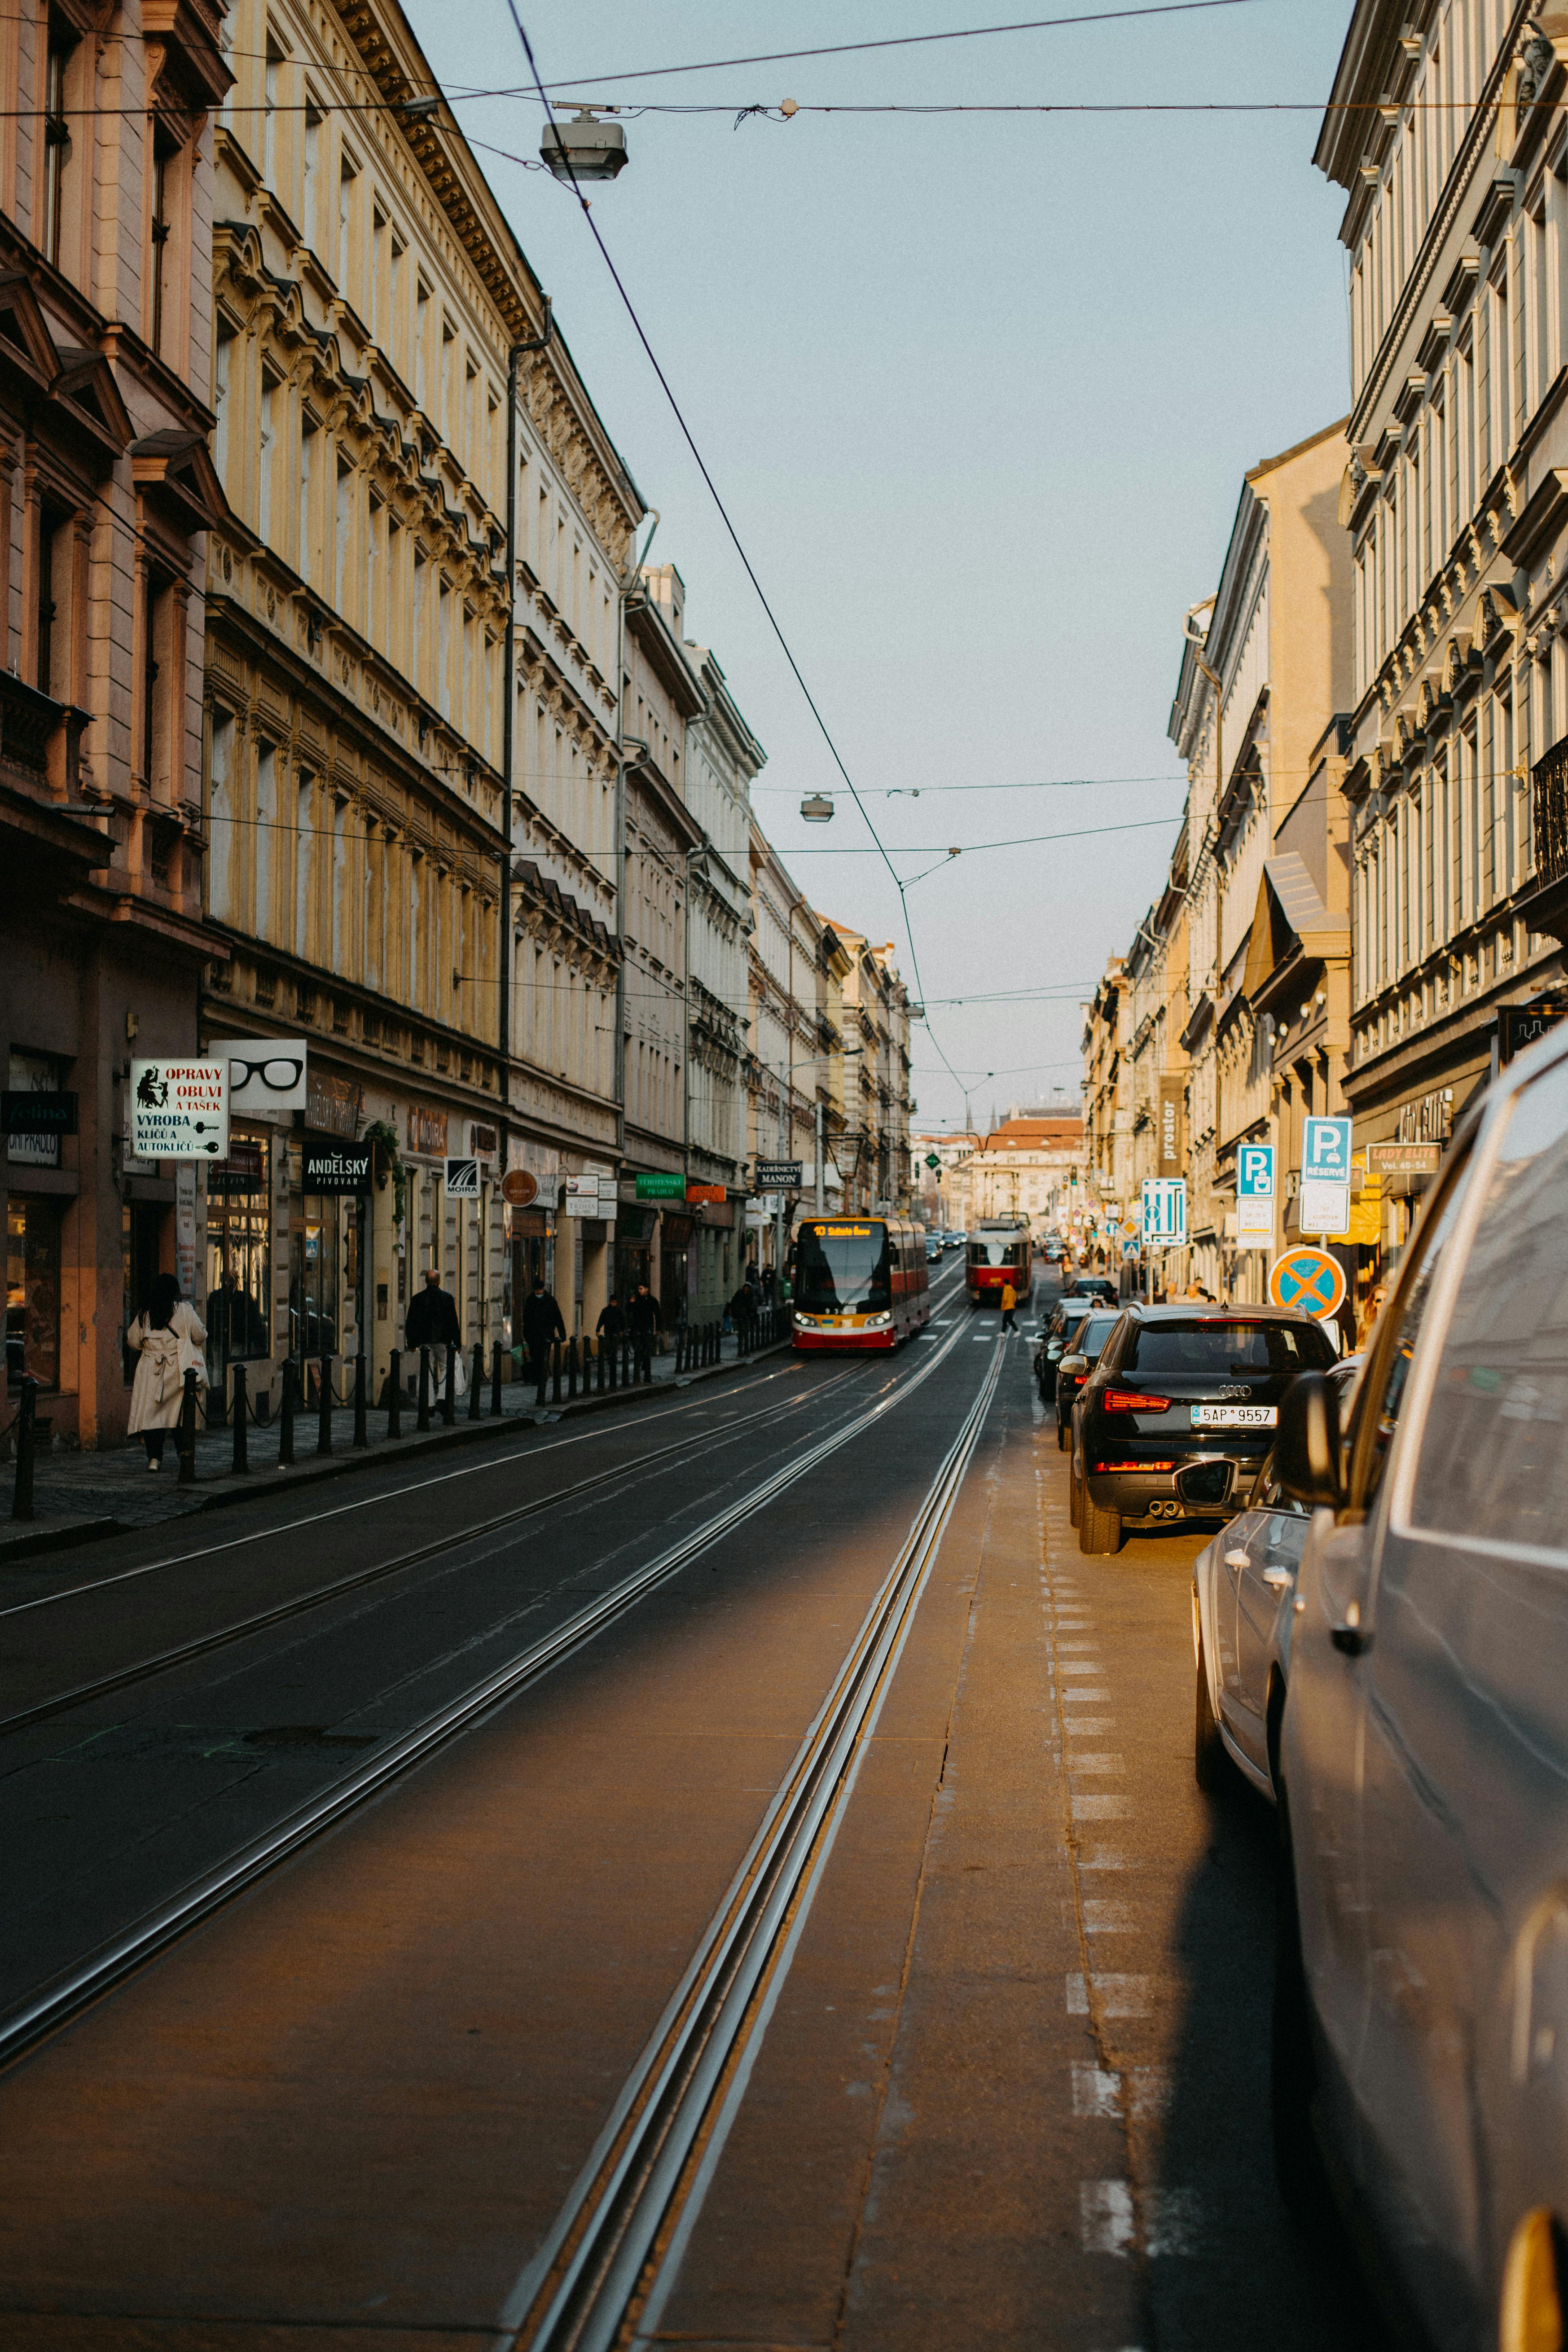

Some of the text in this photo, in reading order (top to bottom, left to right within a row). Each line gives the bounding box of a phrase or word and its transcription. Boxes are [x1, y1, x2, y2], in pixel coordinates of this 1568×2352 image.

[166, 1068, 222, 1080] OPRAVY
[177, 1085, 221, 1097] OBUVI
[176, 1100, 220, 1111] A TAŠEK
[137, 1112, 190, 1126] VÝROBA
[137, 1128, 167, 1139] KLÍČŮ
[170, 1130, 176, 1139] A
[420, 1119, 444, 1148] MOIRA
[1162, 1101, 1177, 1160] prostor
[137, 1141, 193, 1151] AUTOKLÍČŮ
[1373, 1147, 1437, 1160] LADY ELITE
[307, 1152, 369, 1175] ANDĚLSKÝ
[757, 1164, 801, 1172] KADEŘNICTVÍ
[1307, 1166, 1346, 1177] RÉSERVÉ
[316, 1177, 358, 1185] PIVOVAR
[762, 1175, 797, 1183] MANON
[813, 1225, 826, 1236] 10
[1203, 1409, 1270, 1422] 5AP 9557
